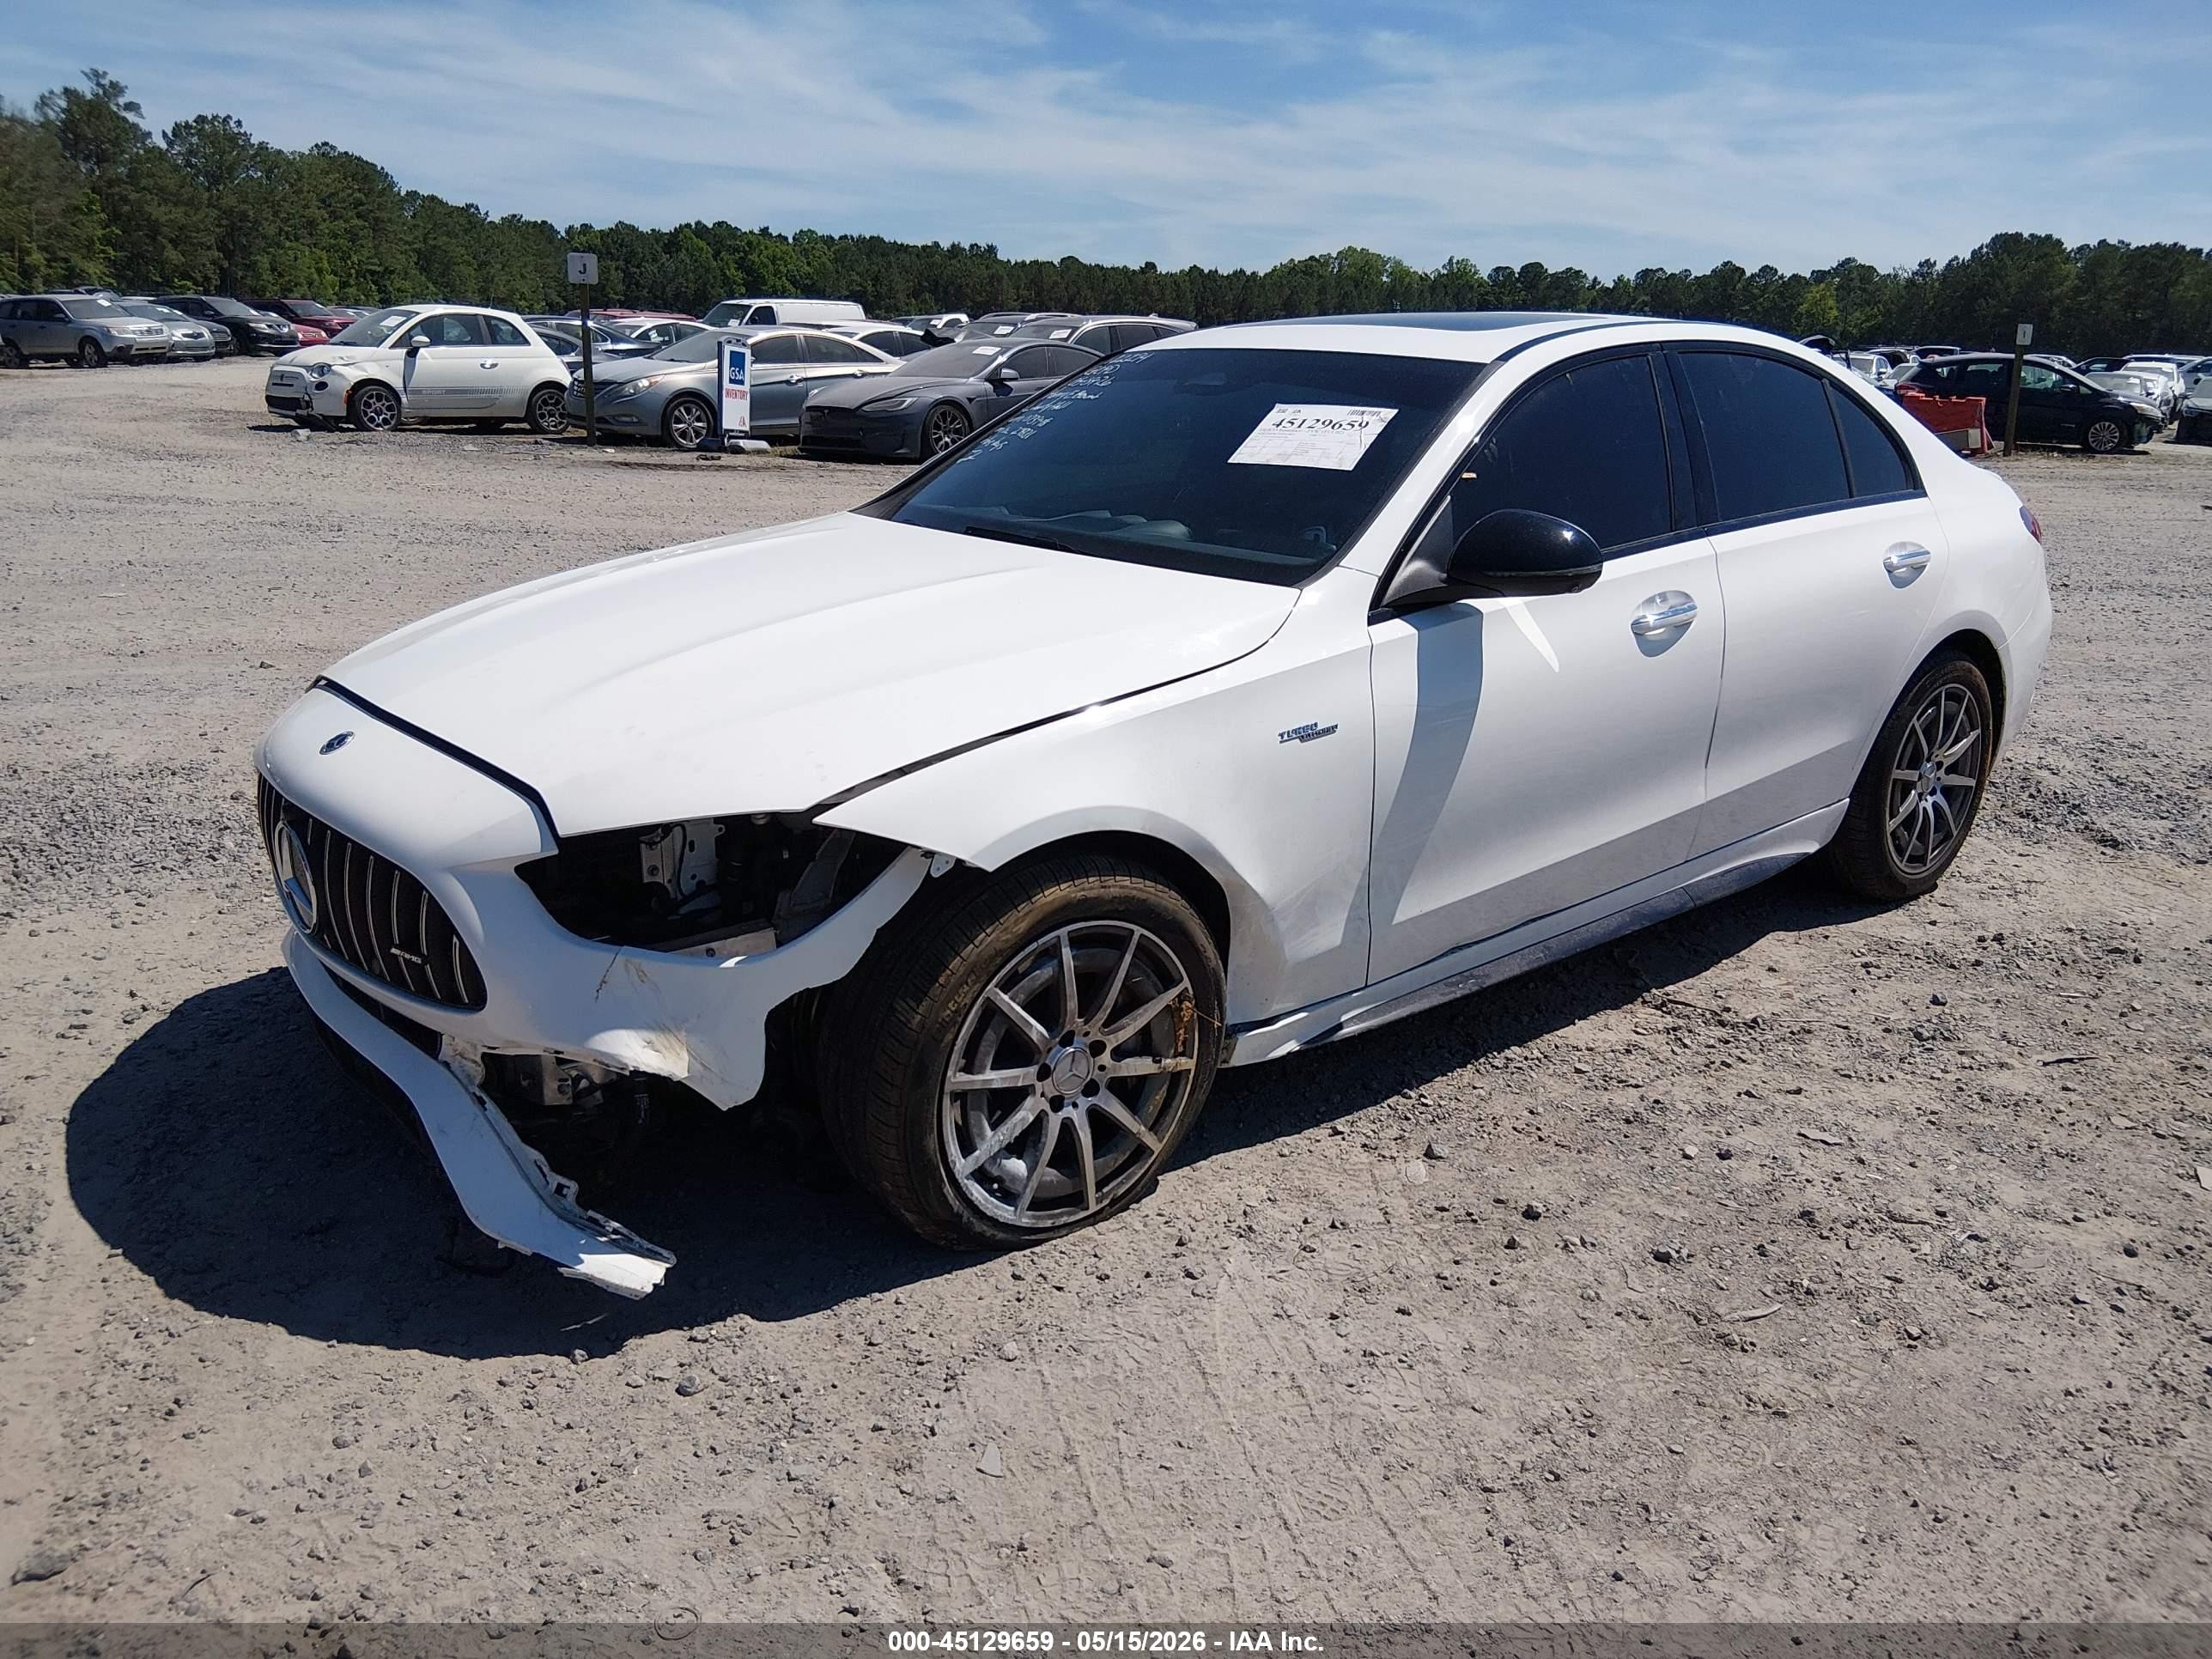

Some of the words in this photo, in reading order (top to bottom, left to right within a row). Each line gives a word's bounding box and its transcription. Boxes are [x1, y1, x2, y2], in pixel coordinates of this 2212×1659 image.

[578, 263, 586, 275] J
[729, 367, 744, 381] GSA
[725, 387, 749, 401] INVENTORY
[1272, 417, 1370, 432] 45129659
